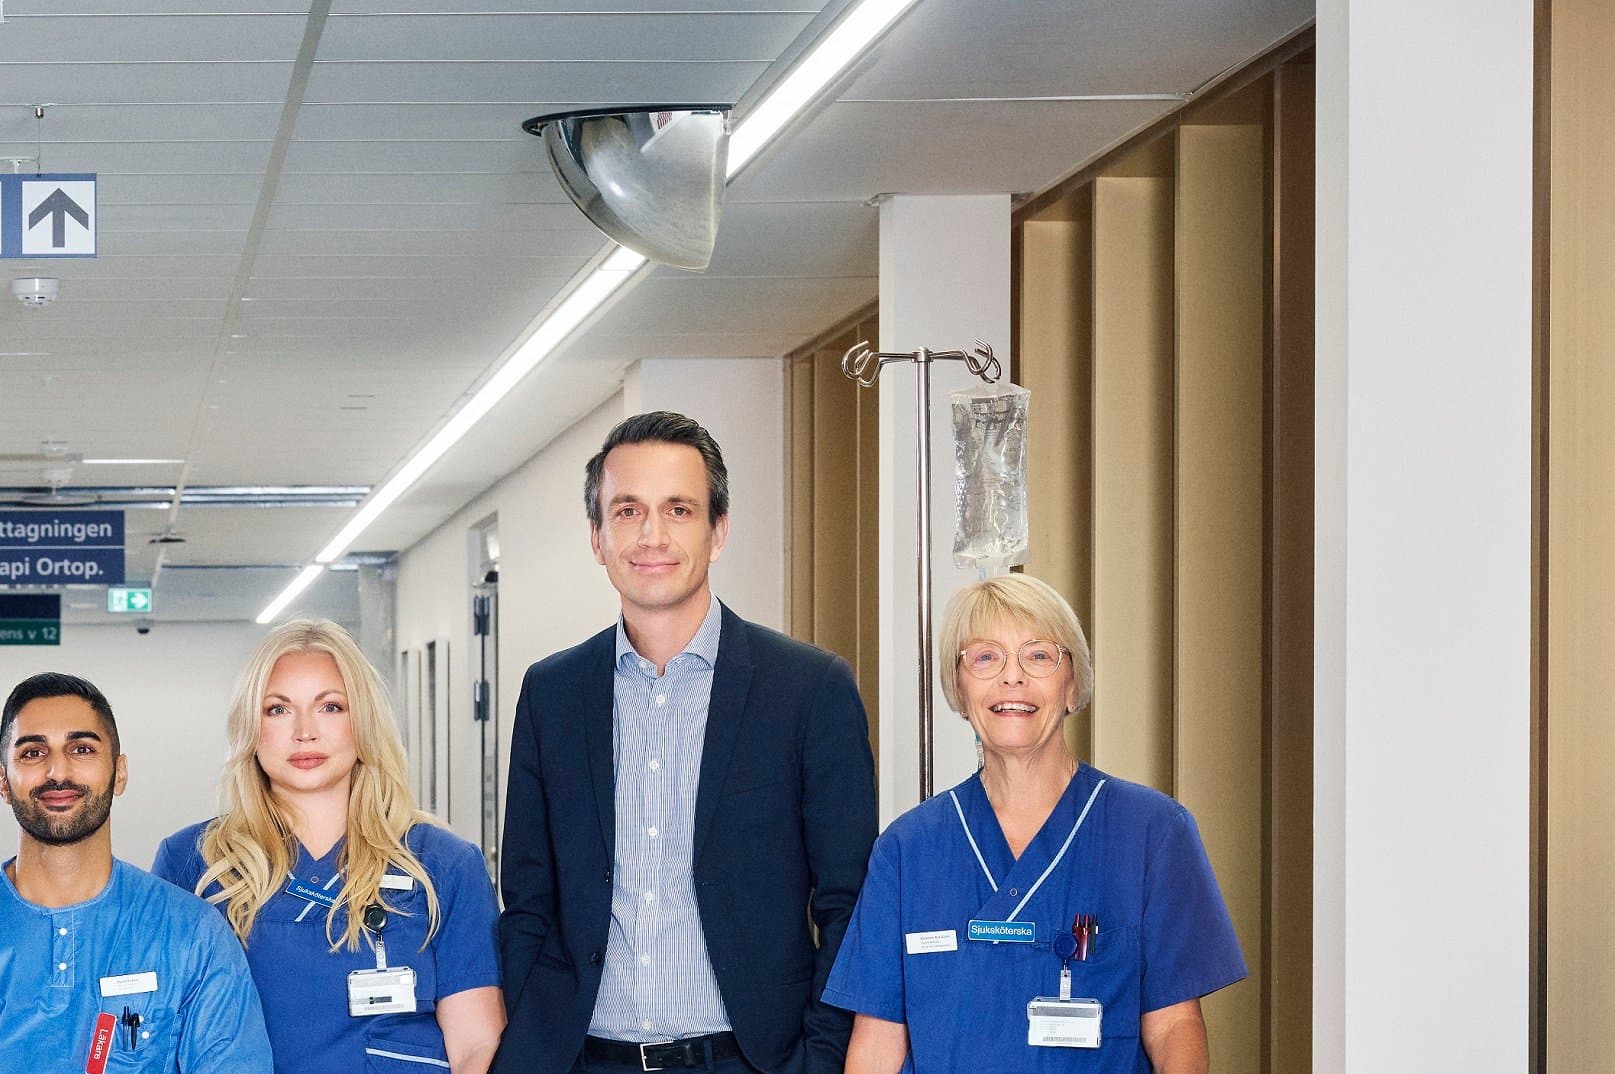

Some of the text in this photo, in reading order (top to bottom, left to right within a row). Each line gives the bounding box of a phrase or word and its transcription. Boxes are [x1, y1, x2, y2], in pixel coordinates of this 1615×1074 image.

[37, 558, 104, 579] Ortop.
[28, 630, 37, 640] v
[42, 626, 57, 639] 12
[971, 925, 1033, 936] Sjuksköterska
[93, 1028, 109, 1060] Läkare
